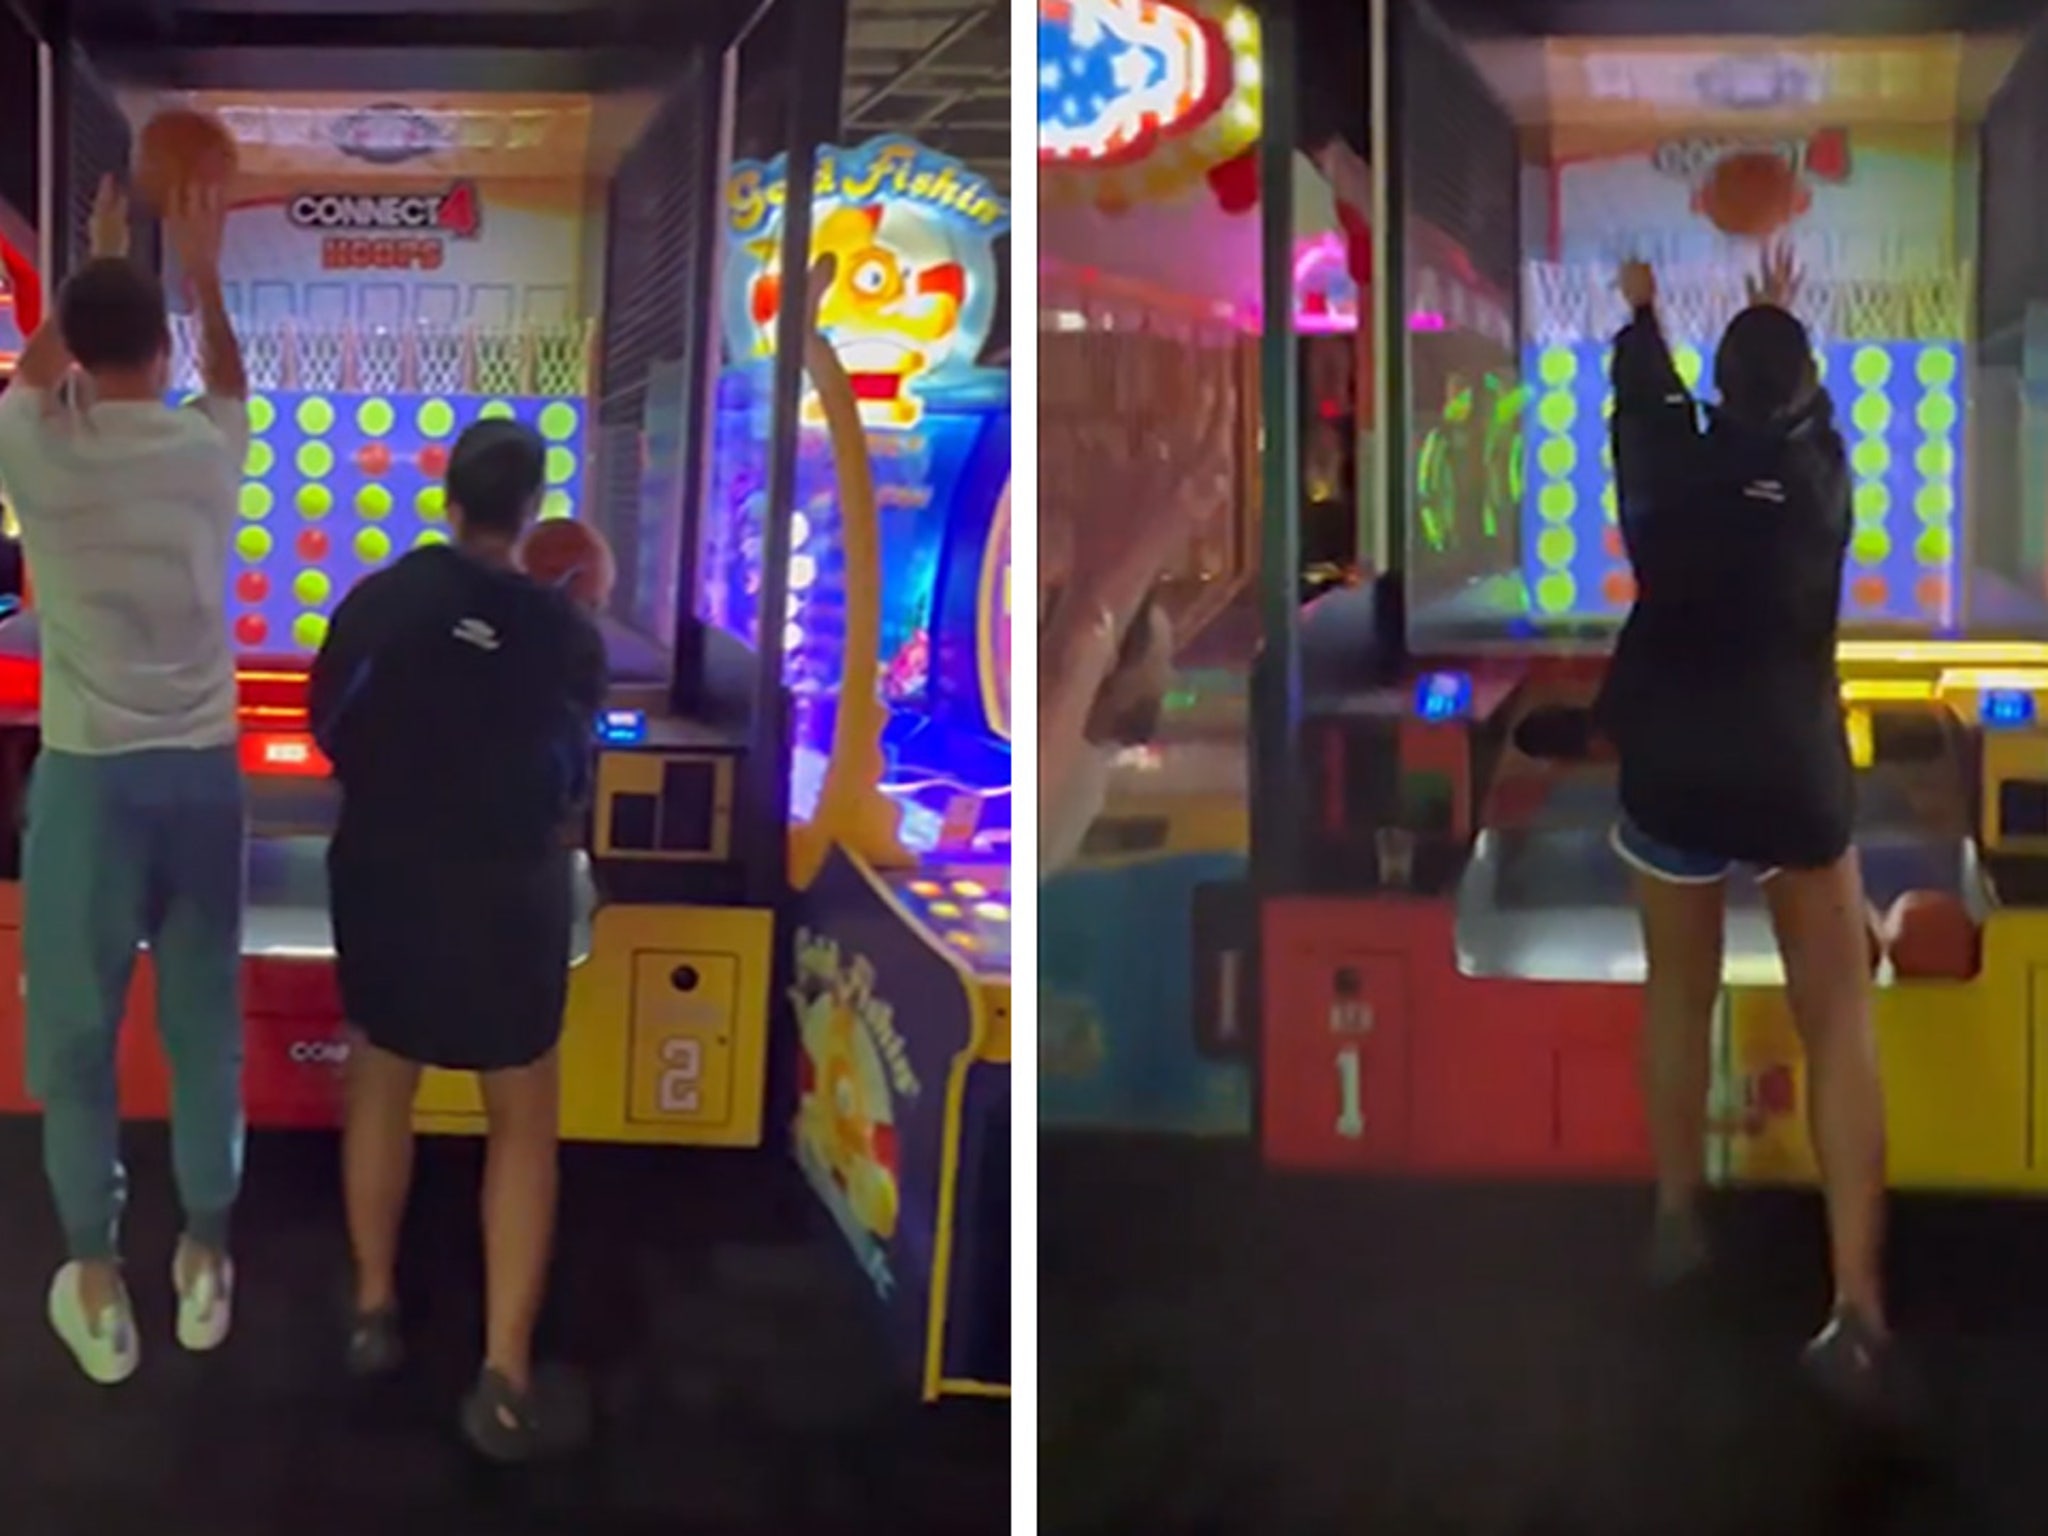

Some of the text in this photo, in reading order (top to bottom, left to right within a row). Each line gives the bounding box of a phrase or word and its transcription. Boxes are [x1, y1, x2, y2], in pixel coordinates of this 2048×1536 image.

[291, 182, 478, 237] CONNECT 4
[661, 1038, 700, 1111] 2
[1336, 1046, 1363, 1138] 1
